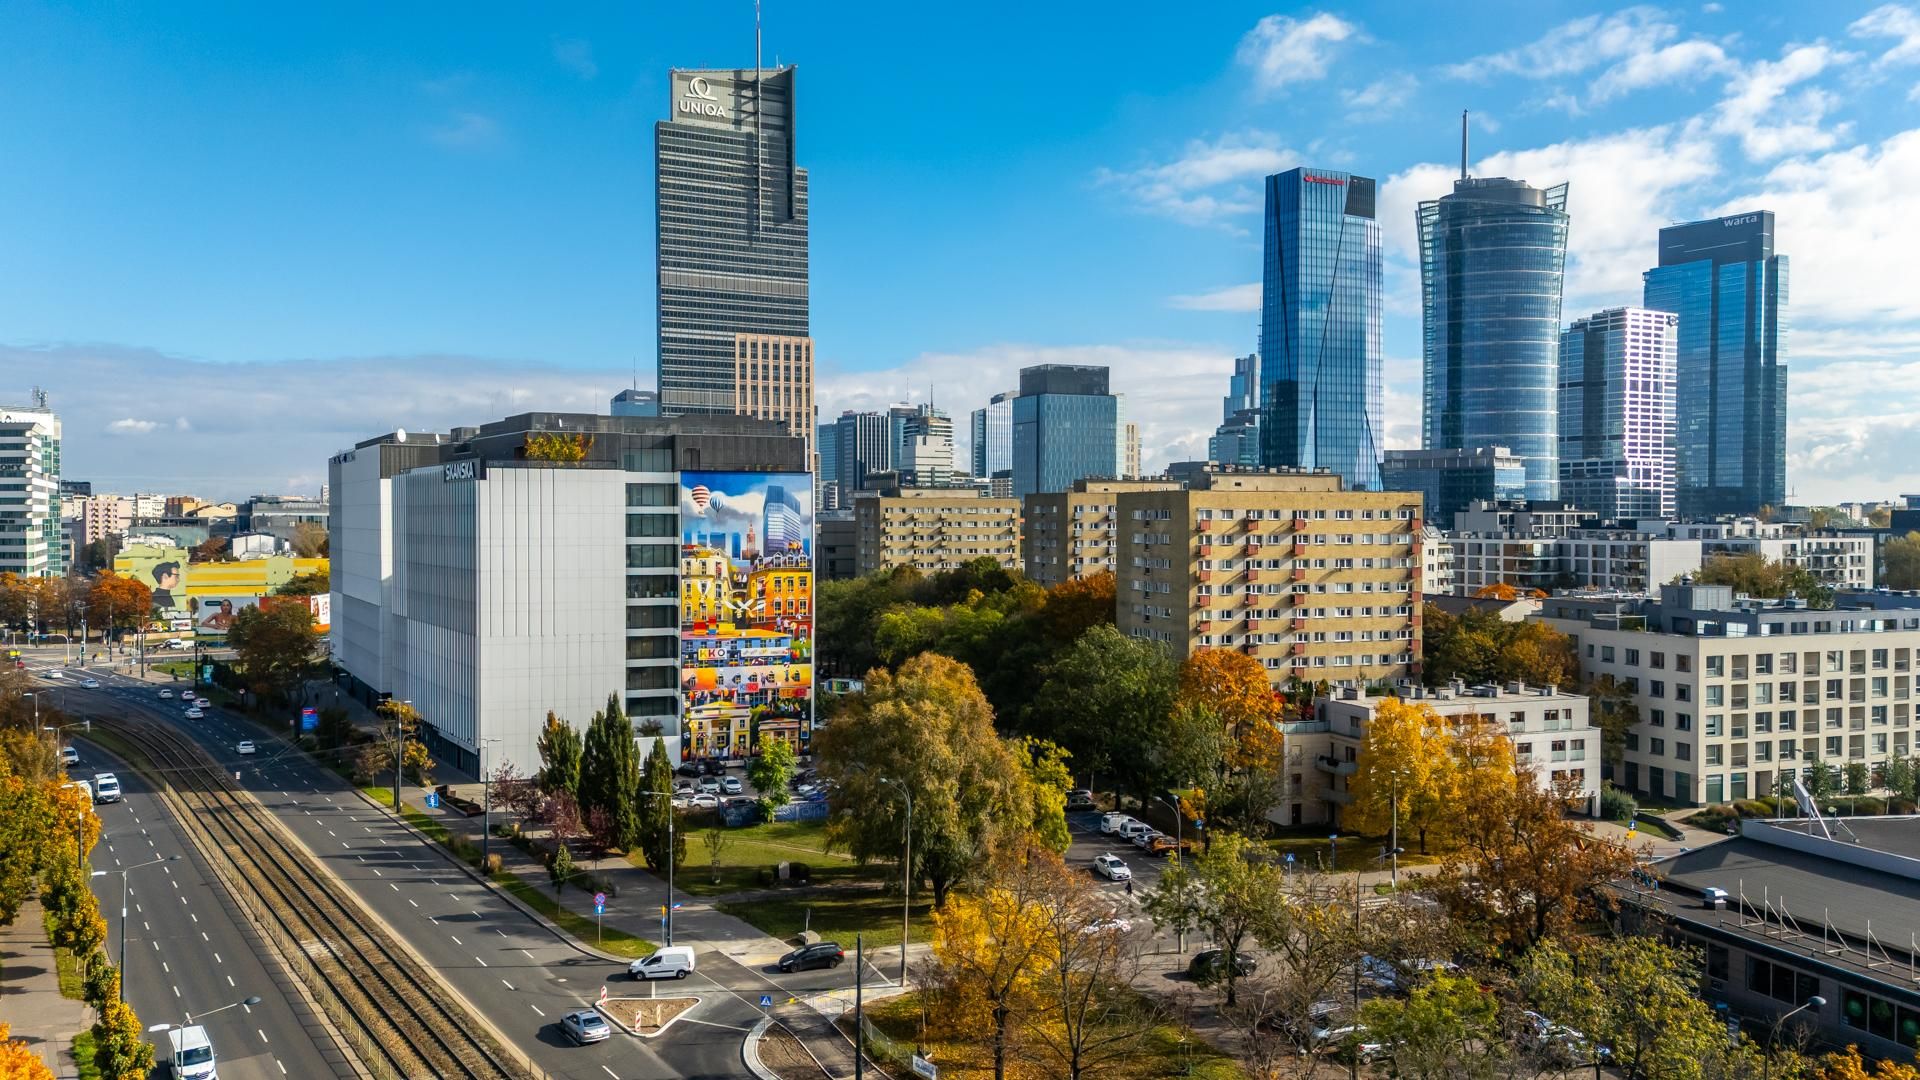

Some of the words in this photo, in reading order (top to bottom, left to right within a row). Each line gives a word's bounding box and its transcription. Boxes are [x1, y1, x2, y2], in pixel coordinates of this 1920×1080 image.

[679, 100, 726, 117] UNIQA
[1723, 215, 1757, 227] warta
[446, 462, 475, 480] SKANSKA
